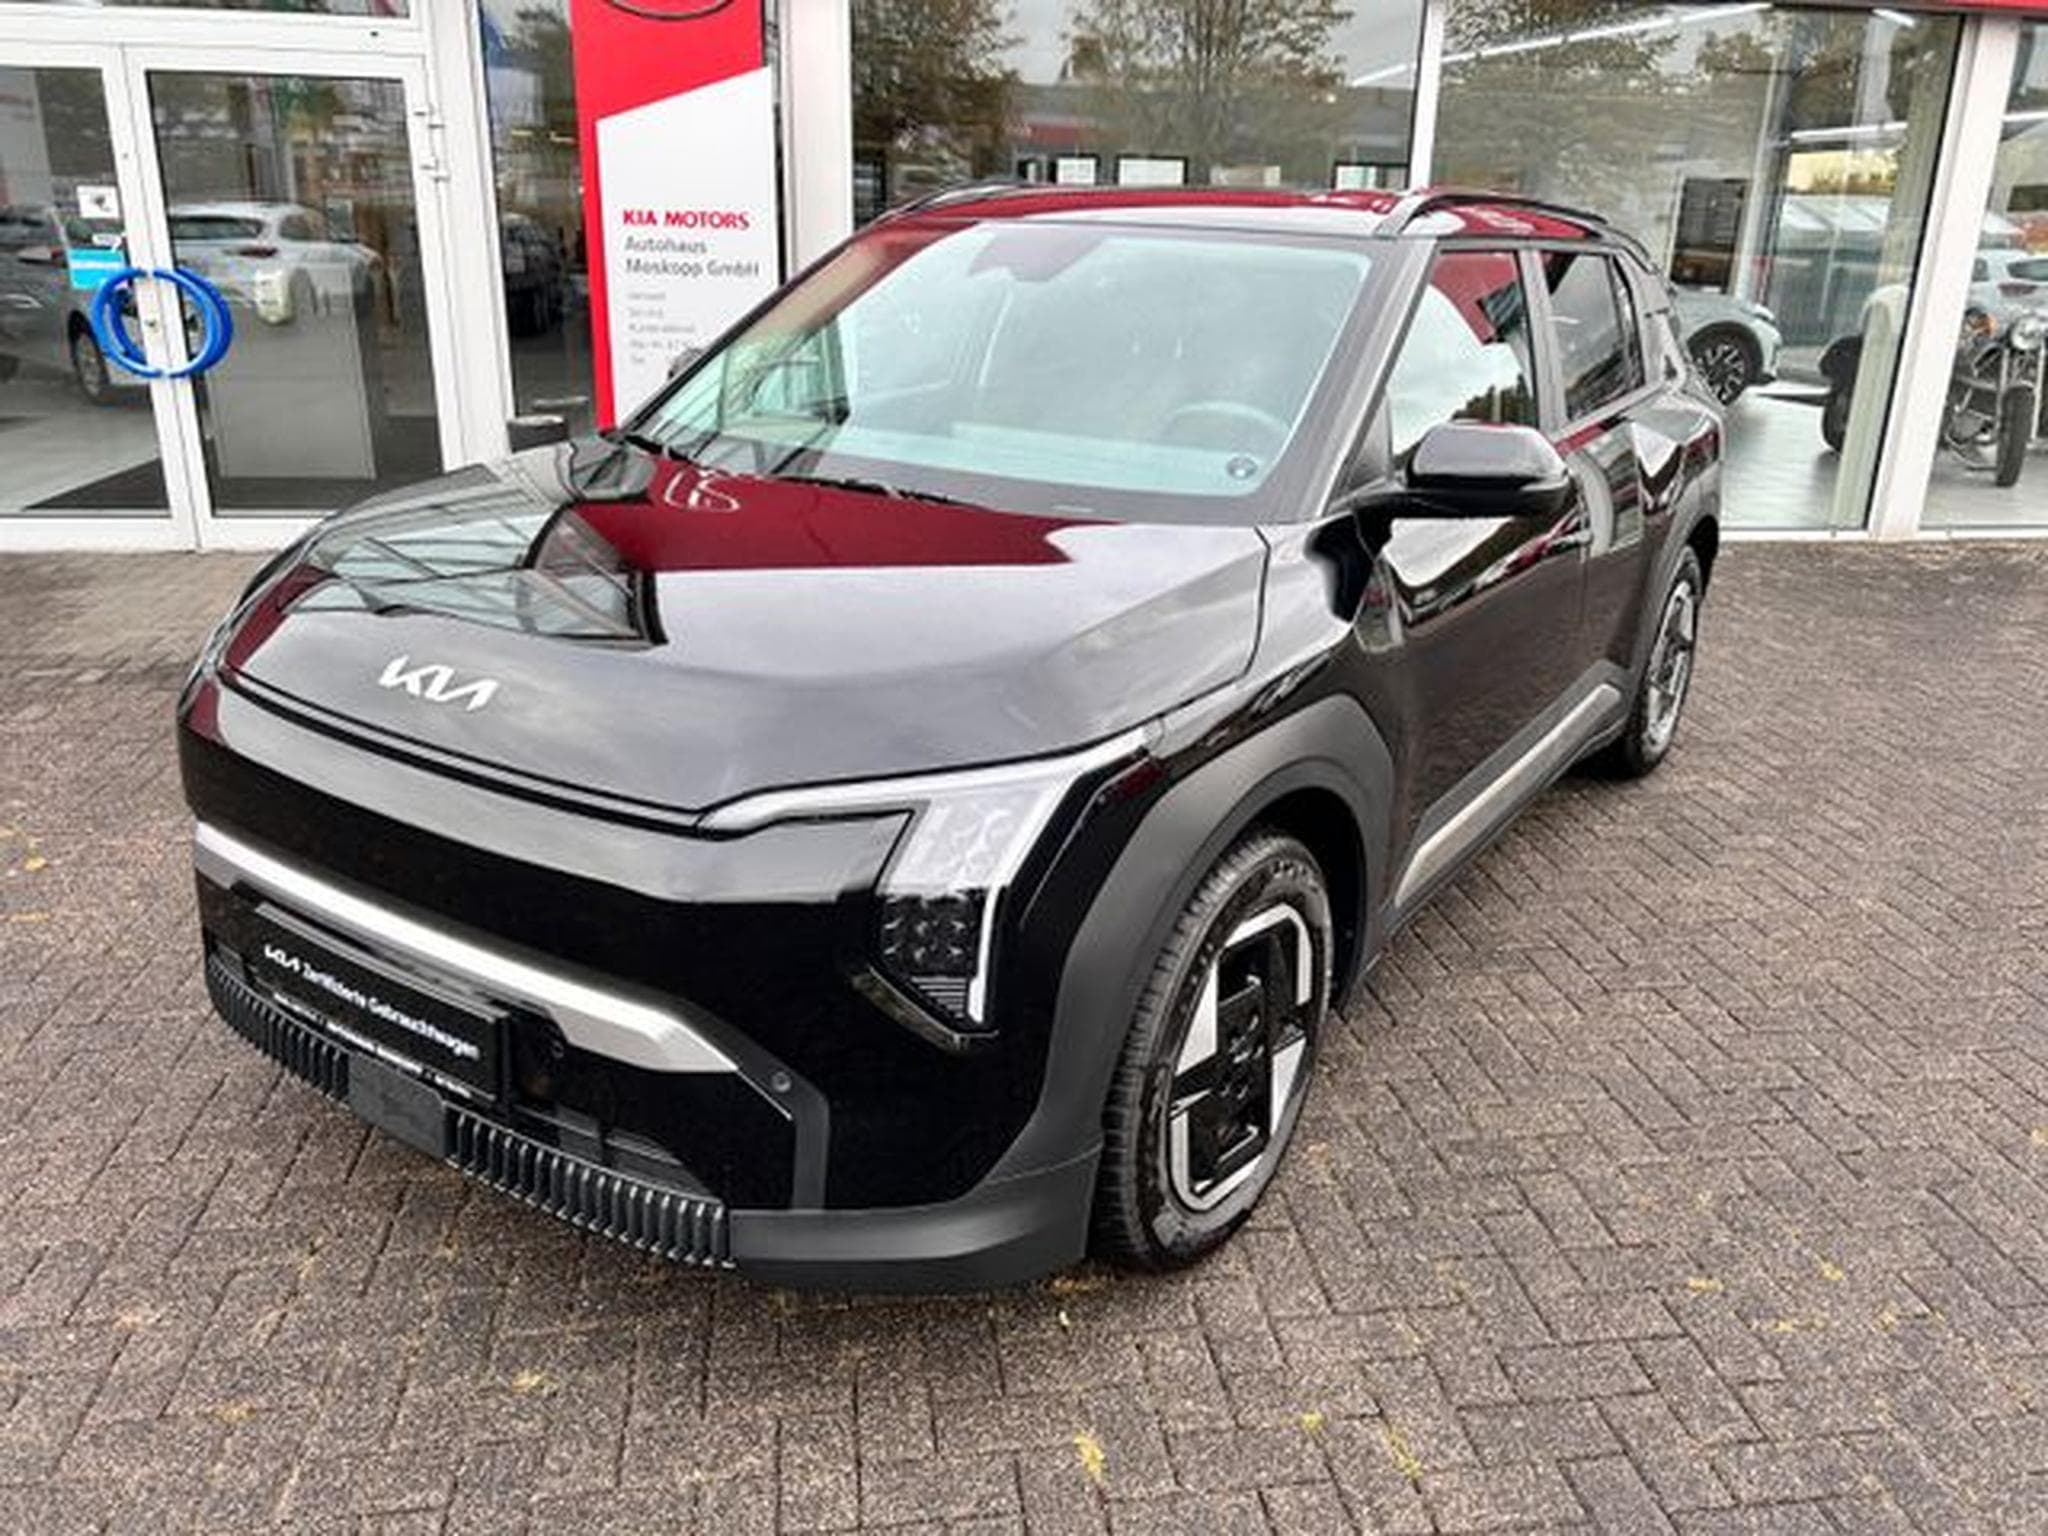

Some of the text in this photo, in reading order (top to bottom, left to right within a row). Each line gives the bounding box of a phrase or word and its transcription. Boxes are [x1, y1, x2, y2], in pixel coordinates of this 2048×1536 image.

[623, 209, 750, 231] KIA MOTORS
[624, 235, 708, 254] Autohaus
[707, 259, 760, 277] GmbH
[378, 654, 499, 712] KIA
